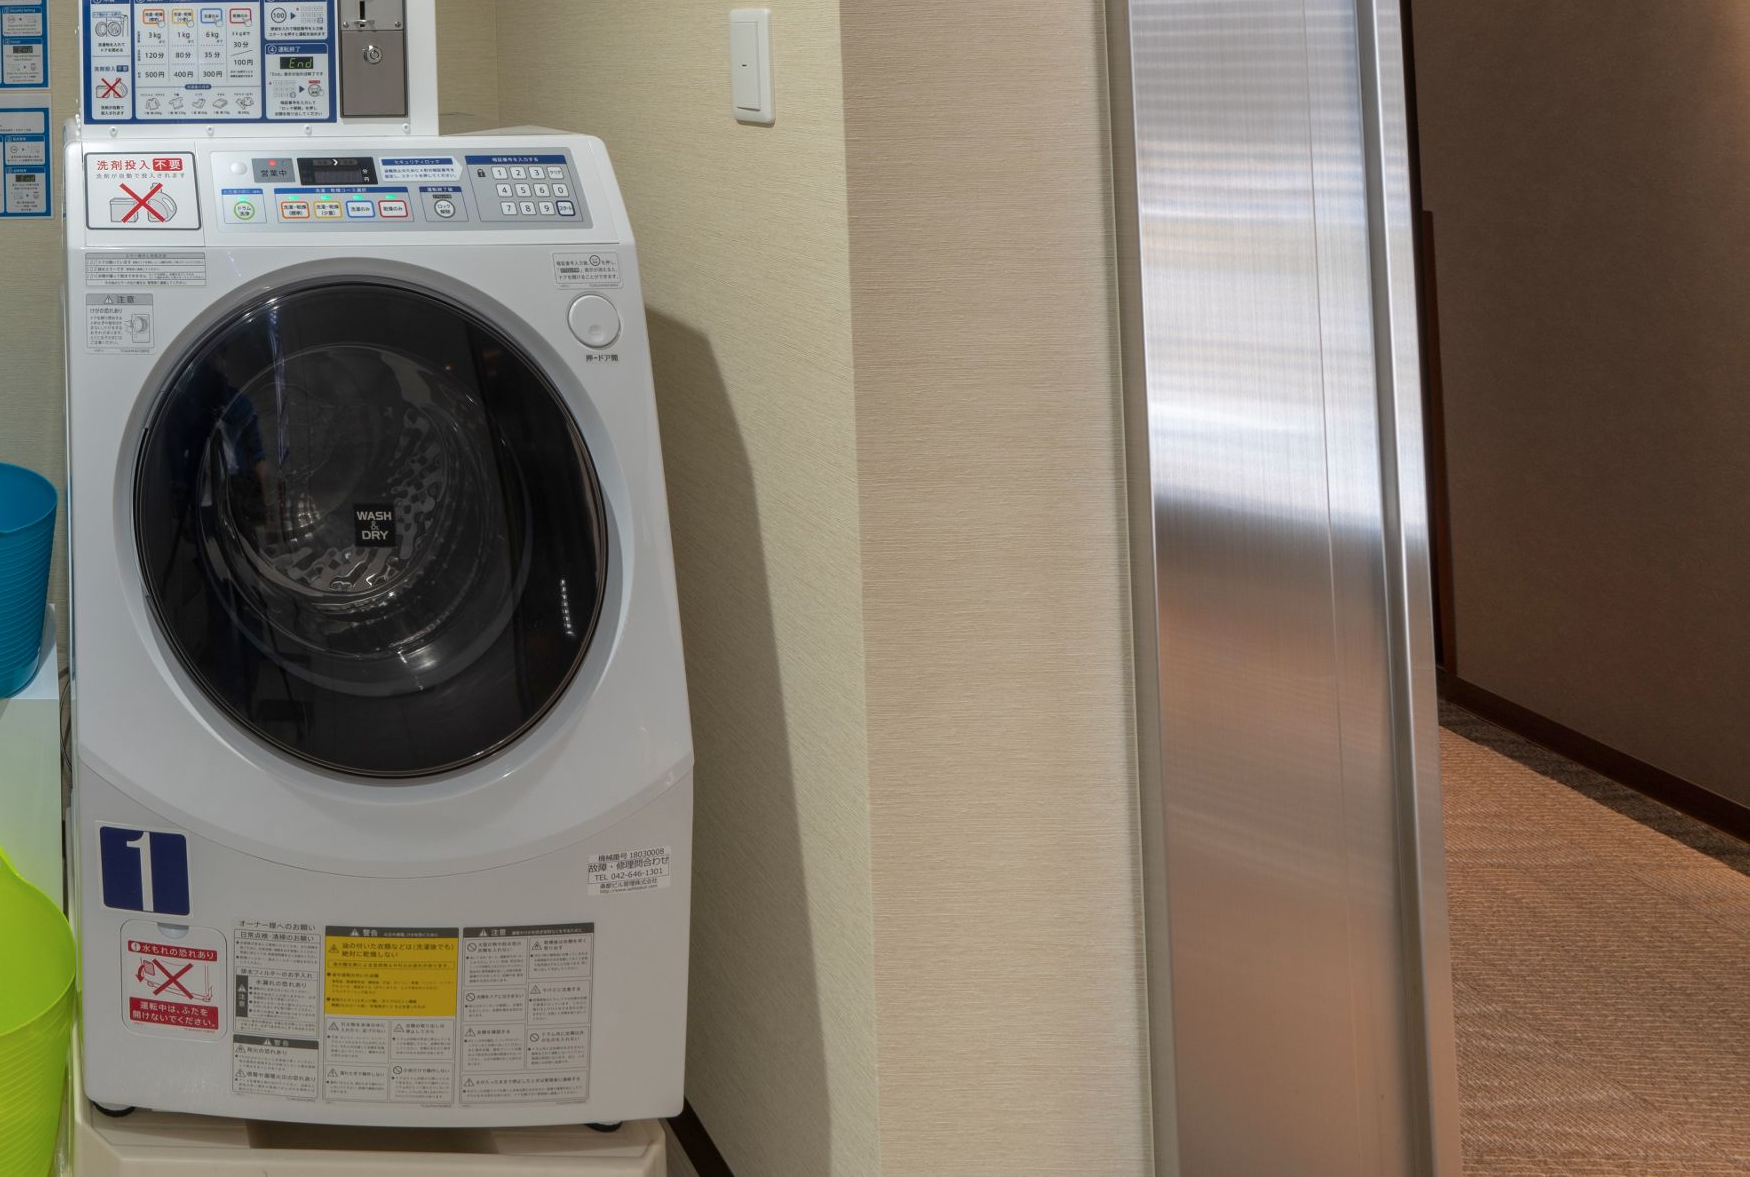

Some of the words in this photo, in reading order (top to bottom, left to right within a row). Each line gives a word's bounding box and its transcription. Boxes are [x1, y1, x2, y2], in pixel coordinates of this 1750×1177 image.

[289, 58, 312, 68] End
[97, 160, 150, 170] 洗剤投入
[154, 160, 181, 170] 不要
[357, 512, 391, 520] WASH
[371, 521, 379, 531] &
[362, 531, 388, 540] DRY
[630, 848, 664, 858] 18030008
[126, 831, 154, 911] 1
[611, 868, 662, 879] 042-646-1301
[142, 944, 214, 959] 水もれの恐れあり
[133, 1011, 215, 1027] 開けないでください。
